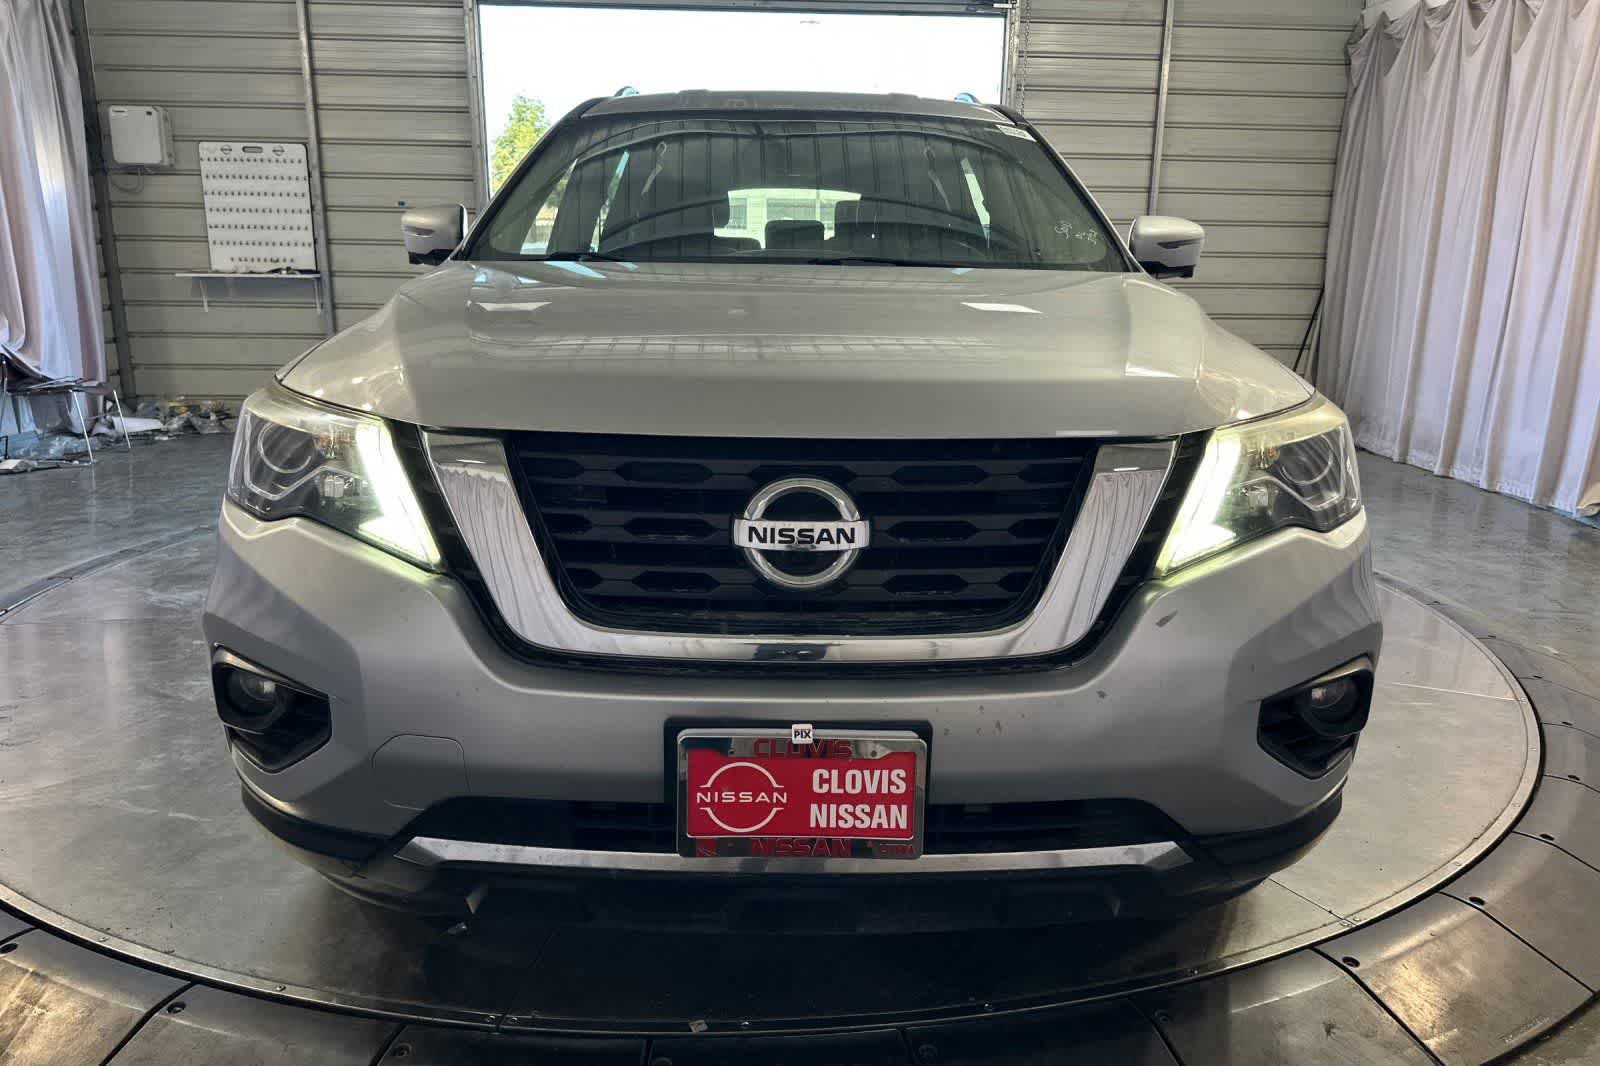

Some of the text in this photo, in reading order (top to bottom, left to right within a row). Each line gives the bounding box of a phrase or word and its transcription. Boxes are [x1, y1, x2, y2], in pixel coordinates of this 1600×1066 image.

[748, 526, 856, 545] NISSAN
[794, 728, 811, 739] PIX
[753, 738, 853, 758] CLOVIS
[812, 768, 907, 794] CLOVIS
[696, 791, 787, 804] NISSAN
[810, 803, 908, 830] NISSAN
[749, 837, 851, 857] NISSAN
